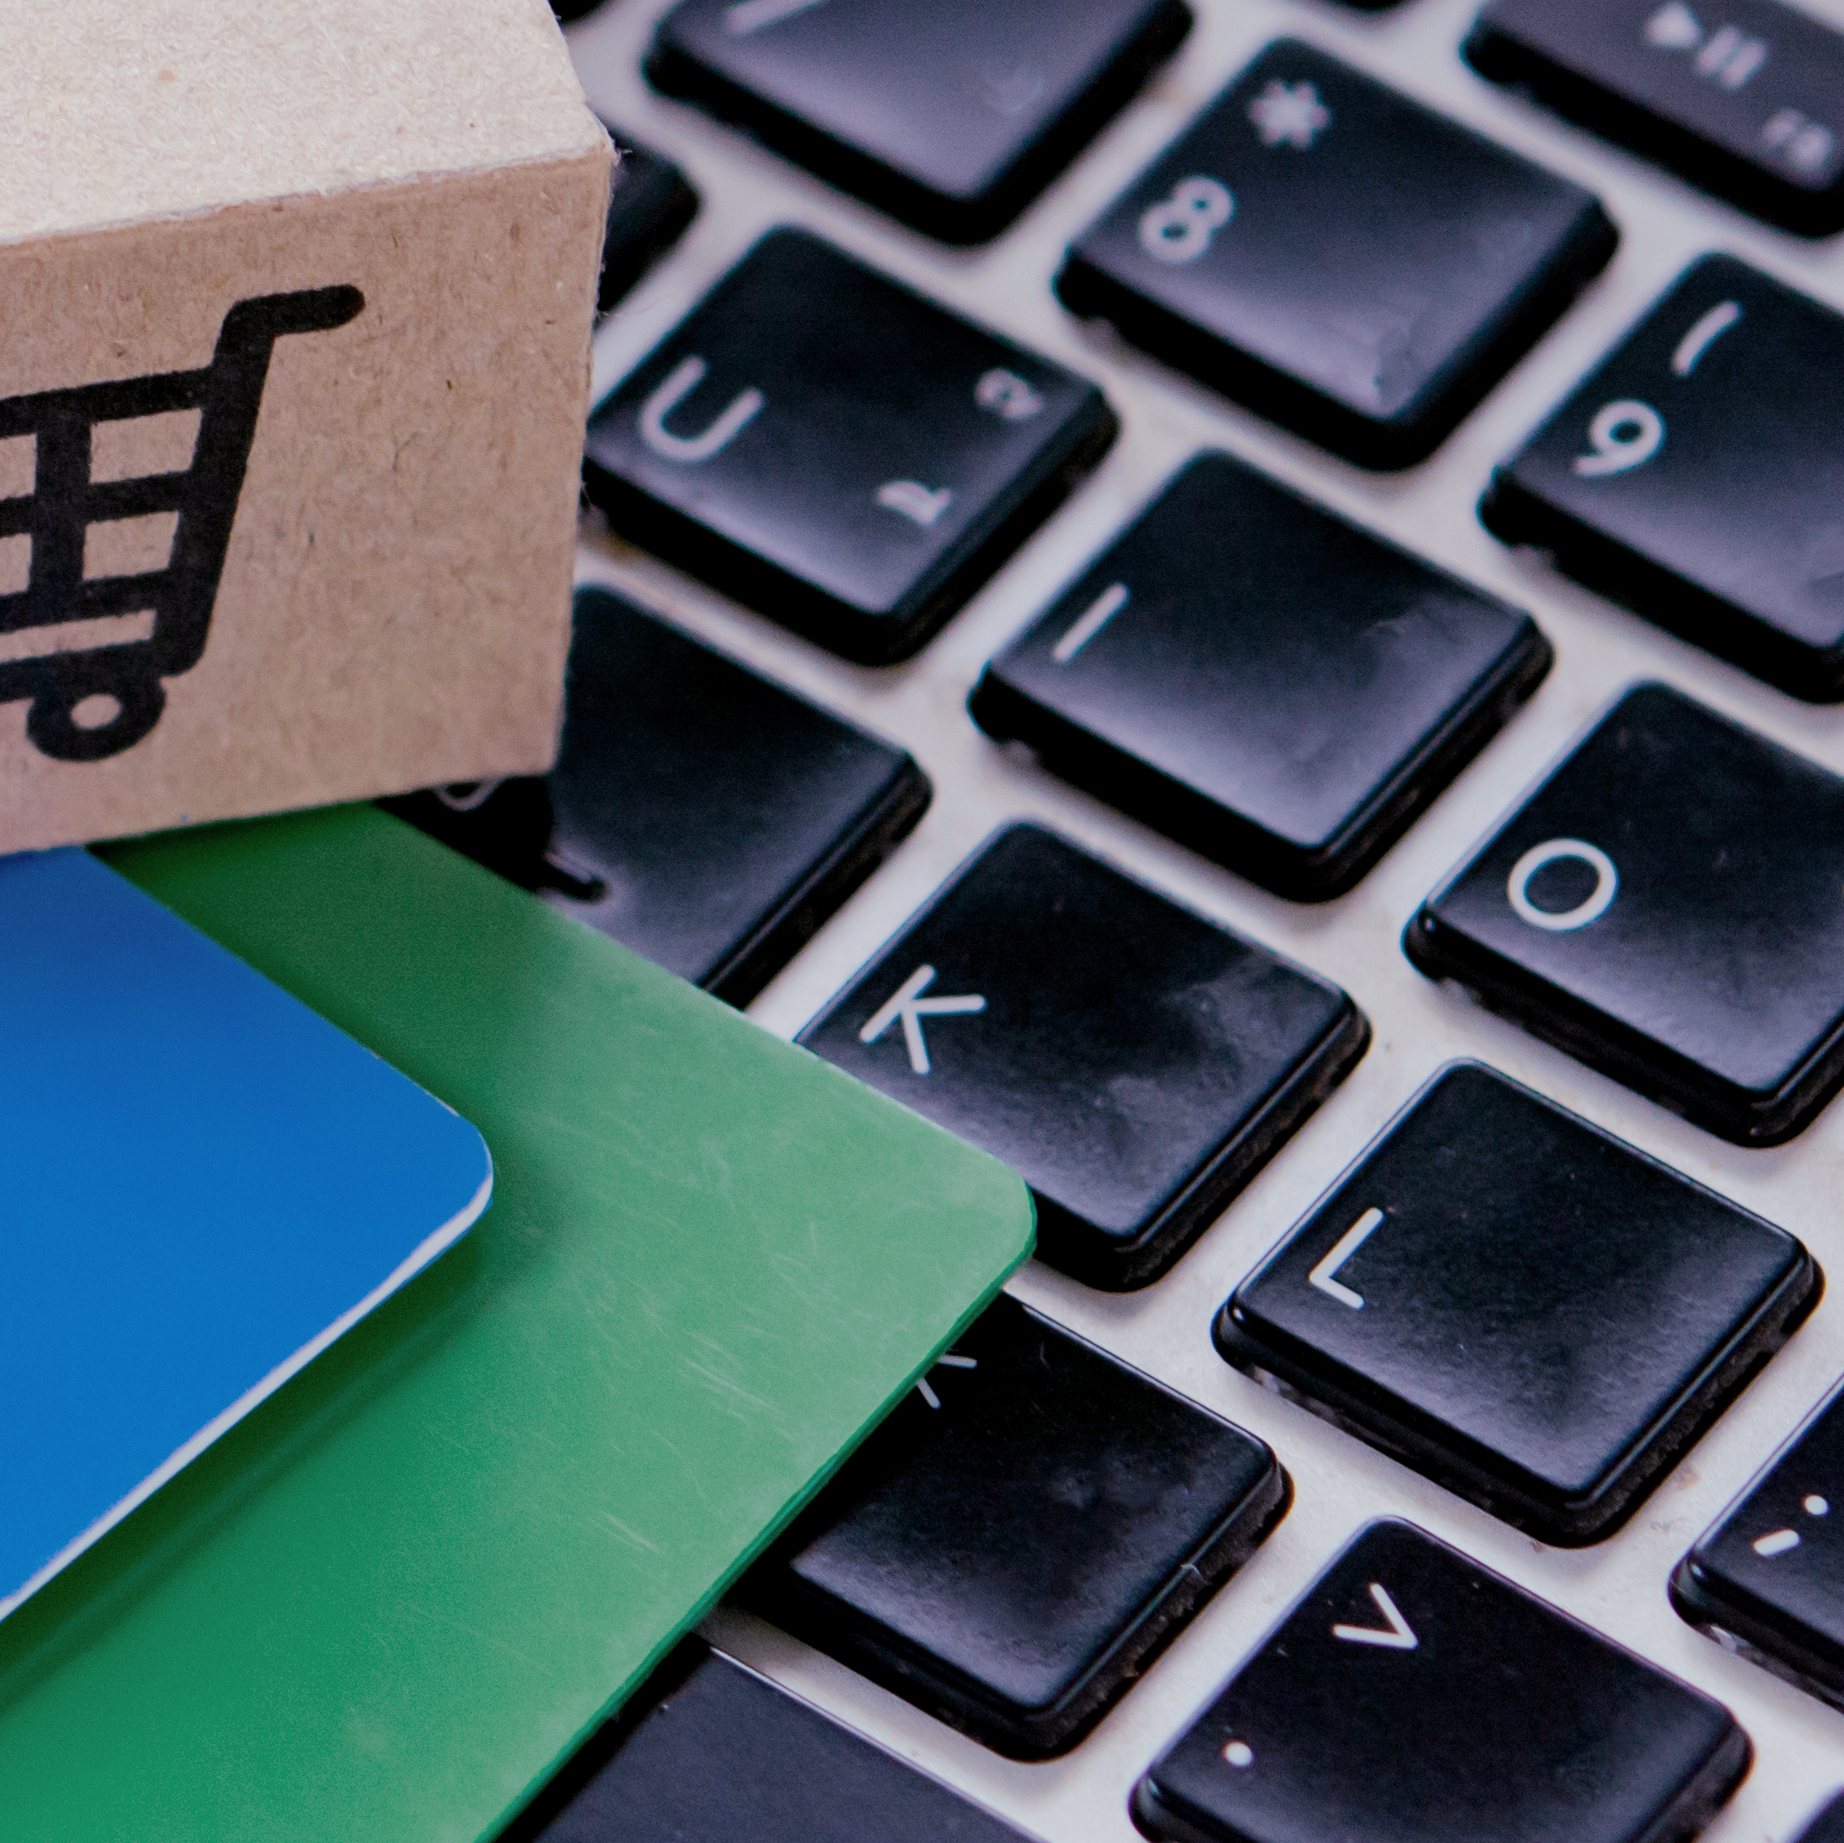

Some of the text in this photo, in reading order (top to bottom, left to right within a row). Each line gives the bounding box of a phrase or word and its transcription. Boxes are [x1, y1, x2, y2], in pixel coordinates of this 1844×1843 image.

[1139, 175, 1235, 262] 8
[639, 356, 764, 459] U
[1573, 399, 1666, 477] 9
[1054, 583, 1129, 661] I
[1508, 838, 1617, 931] O
[859, 964, 986, 1074] K
[1308, 1206, 1385, 1309] L
